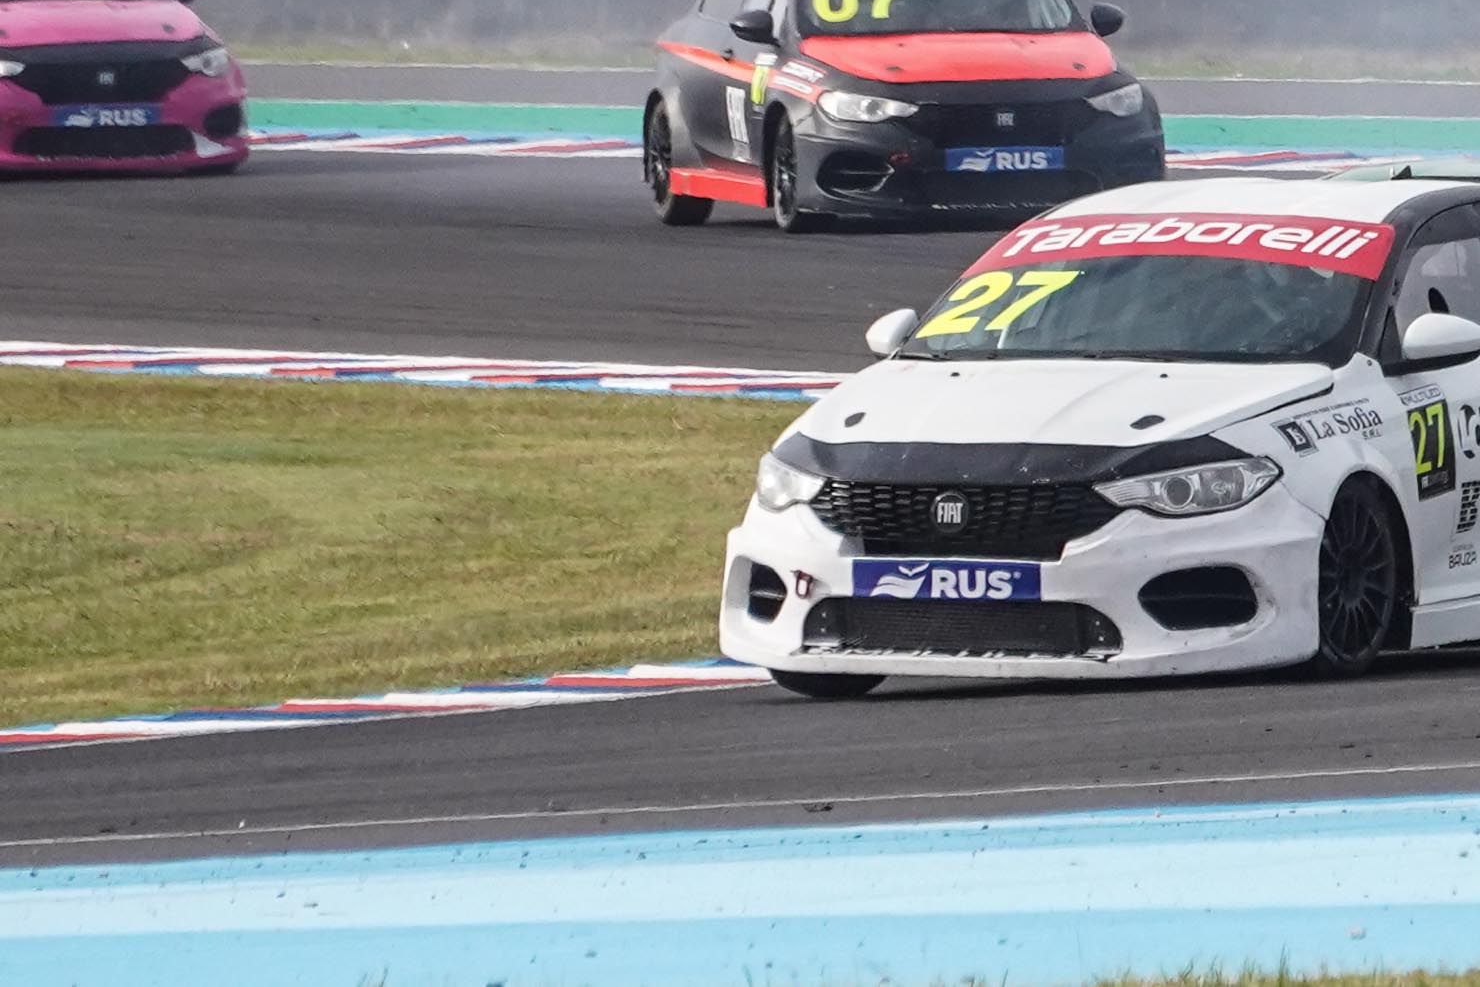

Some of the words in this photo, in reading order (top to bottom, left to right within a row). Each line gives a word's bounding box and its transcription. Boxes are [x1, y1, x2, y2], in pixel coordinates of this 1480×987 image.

[98, 109, 148, 127] RUS
[995, 151, 1048, 171] RUS
[1002, 217, 1379, 259] Taraborelli
[915, 270, 1082, 340] 27
[1306, 419, 1337, 440] La
[1332, 406, 1384, 435] Sofia
[1409, 402, 1446, 475] 27
[936, 502, 964, 524] FIAT
[930, 568, 1013, 600] RUS
